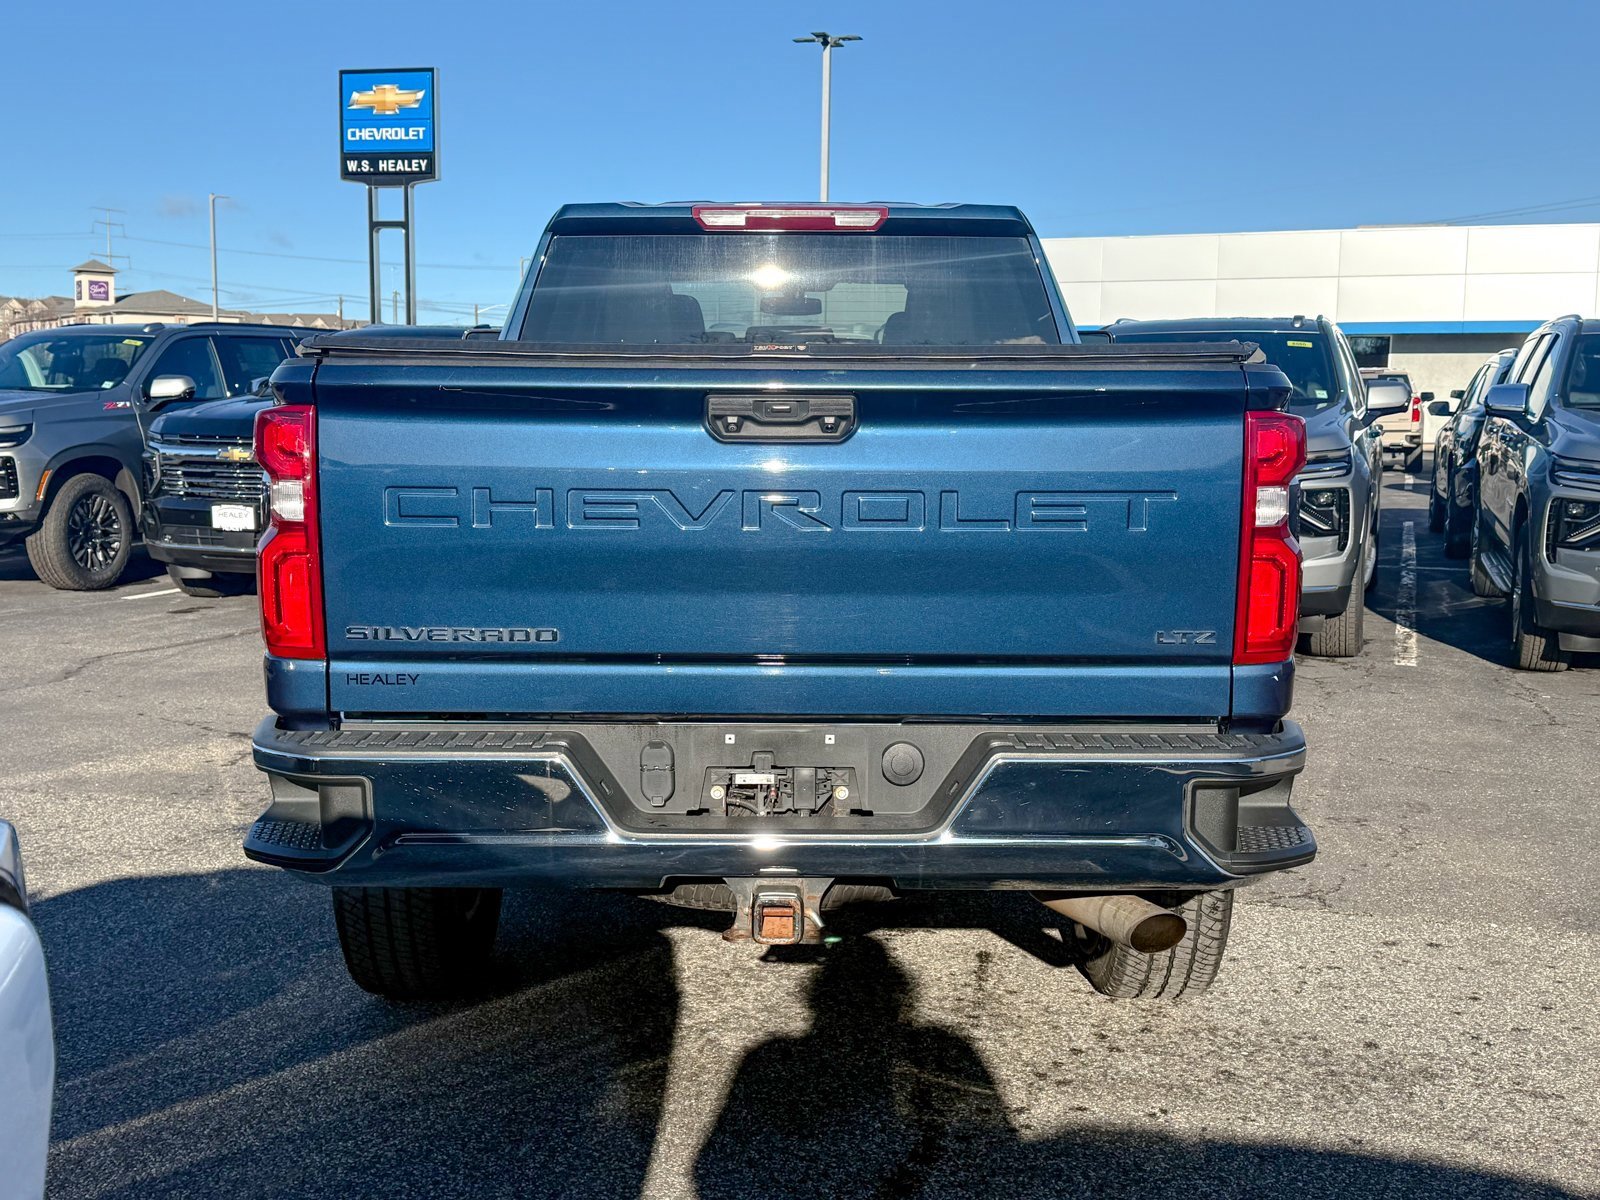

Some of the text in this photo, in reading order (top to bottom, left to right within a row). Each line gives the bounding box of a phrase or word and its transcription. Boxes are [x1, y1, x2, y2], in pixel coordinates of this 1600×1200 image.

[347, 127, 426, 140] CHEVROLET
[346, 159, 428, 172] W.S. HEALEY
[218, 511, 249, 519] HEALEY
[383, 486, 1179, 533] CHEVROLET
[345, 626, 560, 643] SILVERADO
[1155, 630, 1217, 645] LTZ
[346, 673, 420, 686] HEALEY
